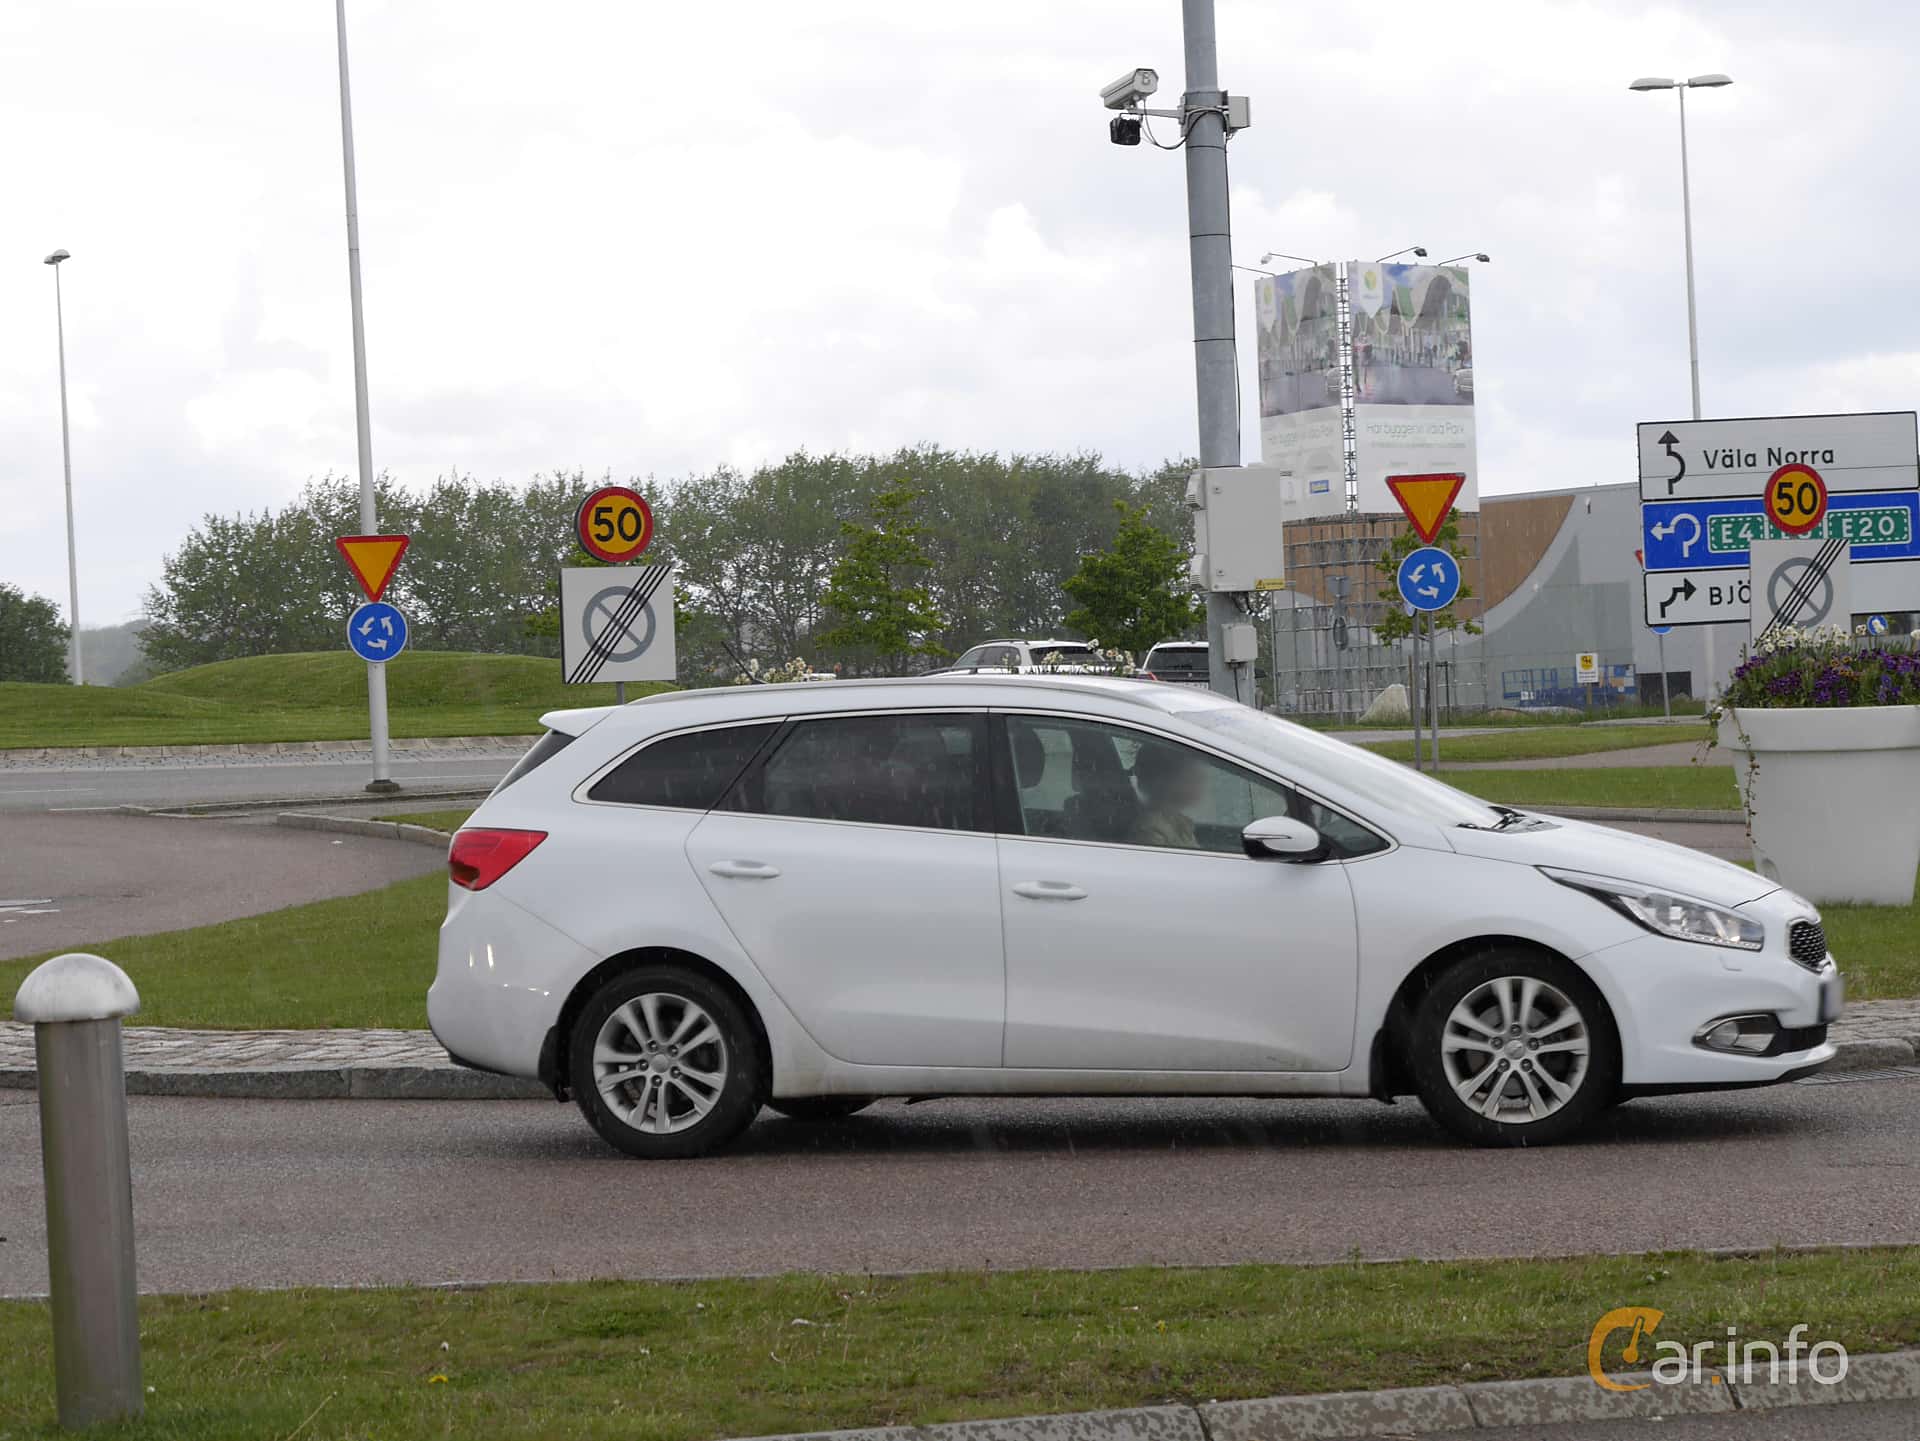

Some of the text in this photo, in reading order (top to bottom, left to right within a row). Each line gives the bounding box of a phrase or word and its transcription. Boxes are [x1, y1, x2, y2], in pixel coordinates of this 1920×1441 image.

[1703, 447, 1834, 469] Väla Norra
[1776, 482, 1818, 516] 50
[594, 506, 642, 542] 50
[1721, 522, 1754, 544] E4
[1842, 515, 1895, 538] E20
[1708, 579, 1751, 606] BJÖ
